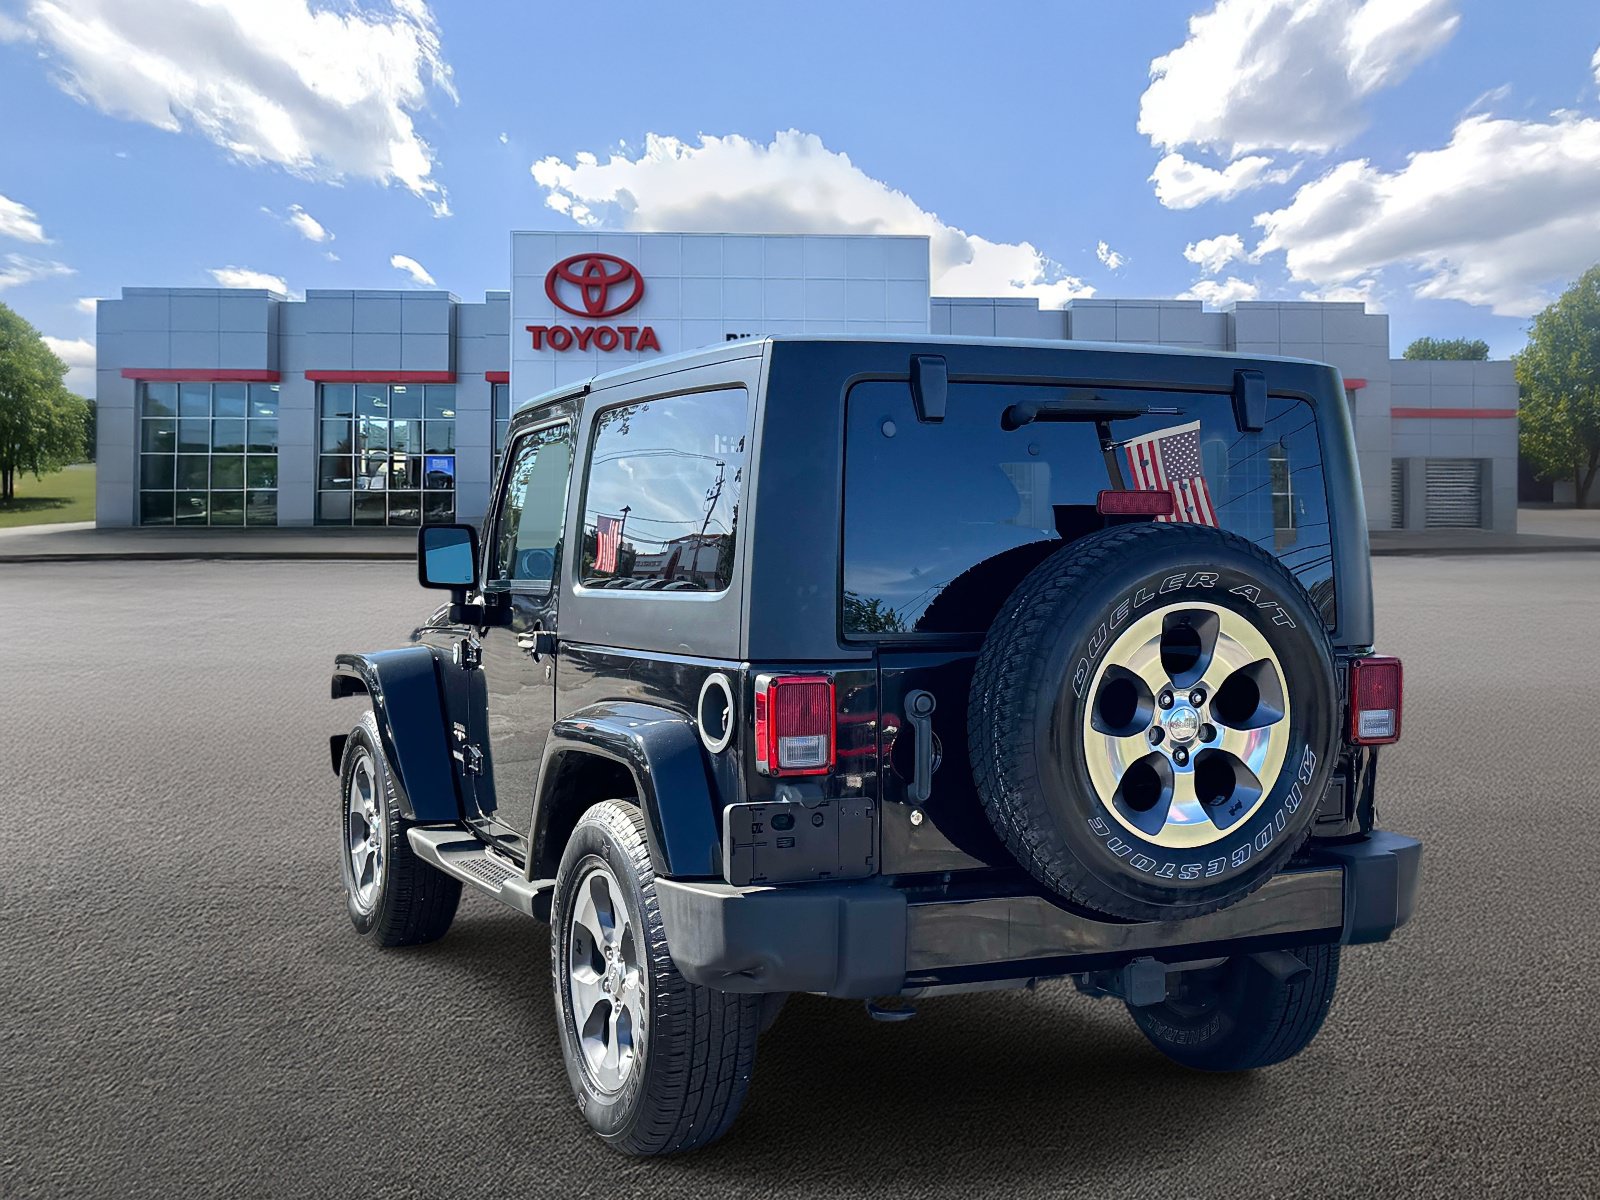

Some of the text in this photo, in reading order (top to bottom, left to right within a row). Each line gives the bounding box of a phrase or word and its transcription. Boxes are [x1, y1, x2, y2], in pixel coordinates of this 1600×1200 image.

[525, 325, 661, 352] TOYOTA
[1072, 571, 1297, 699] DUELER A/T
[1087, 743, 1318, 881] BRIDGESTONE
[1146, 1012, 1221, 1045] GENERAL
